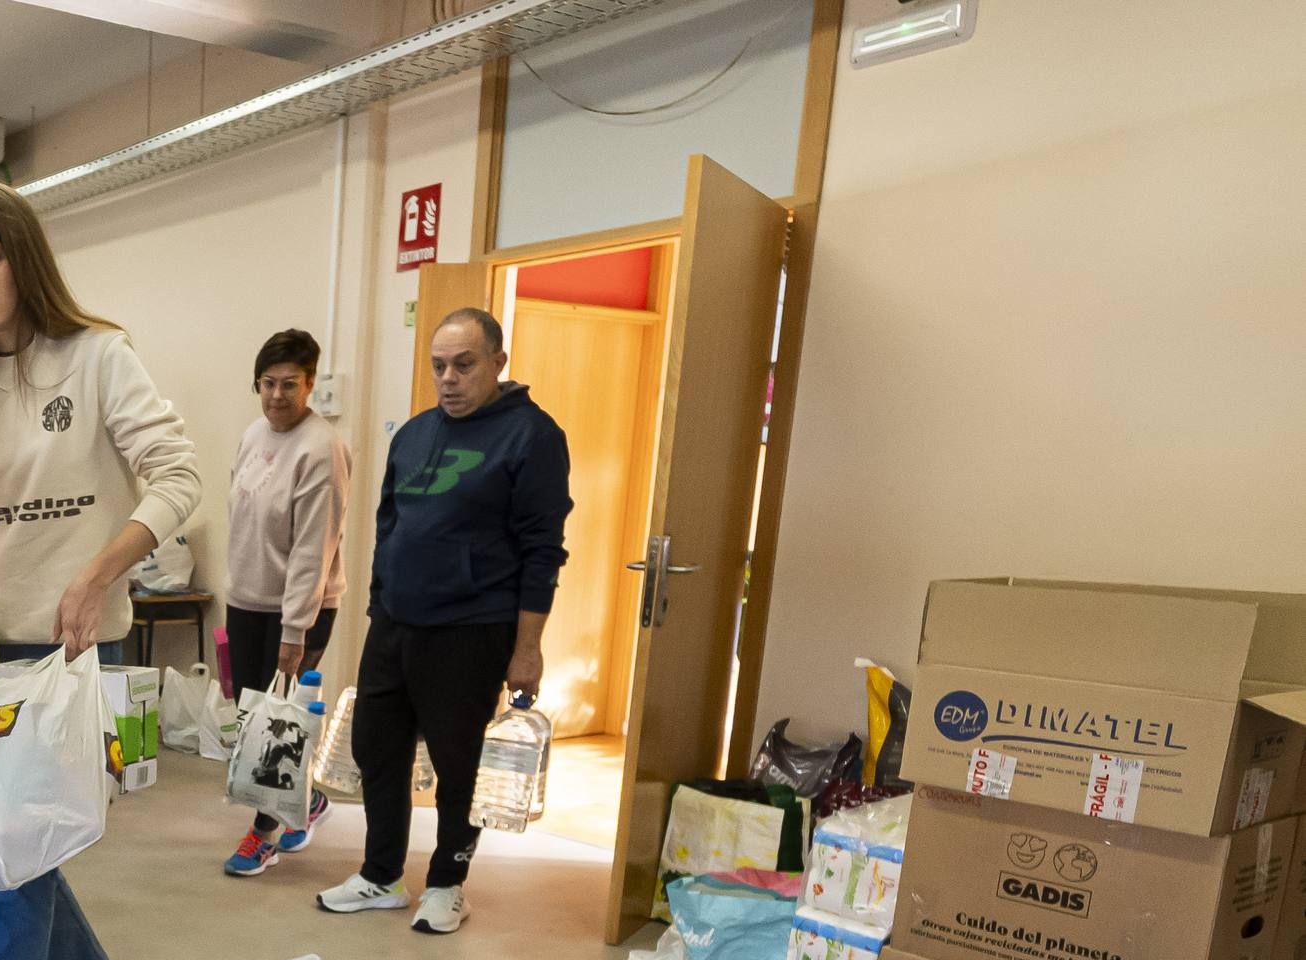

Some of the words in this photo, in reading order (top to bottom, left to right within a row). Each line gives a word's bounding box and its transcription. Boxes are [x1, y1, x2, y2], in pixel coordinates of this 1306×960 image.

[940, 705, 980, 725] EDM
[995, 699, 1188, 750] DIMATEL
[1089, 773, 1110, 817] FRÁGIL
[1002, 877, 1085, 912] GADIS
[921, 918, 952, 934] Otras
[954, 928, 983, 941] cajas
[984, 936, 1044, 959] recicladas
[955, 911, 1009, 937] Cuido
[1012, 927, 1042, 945] del
